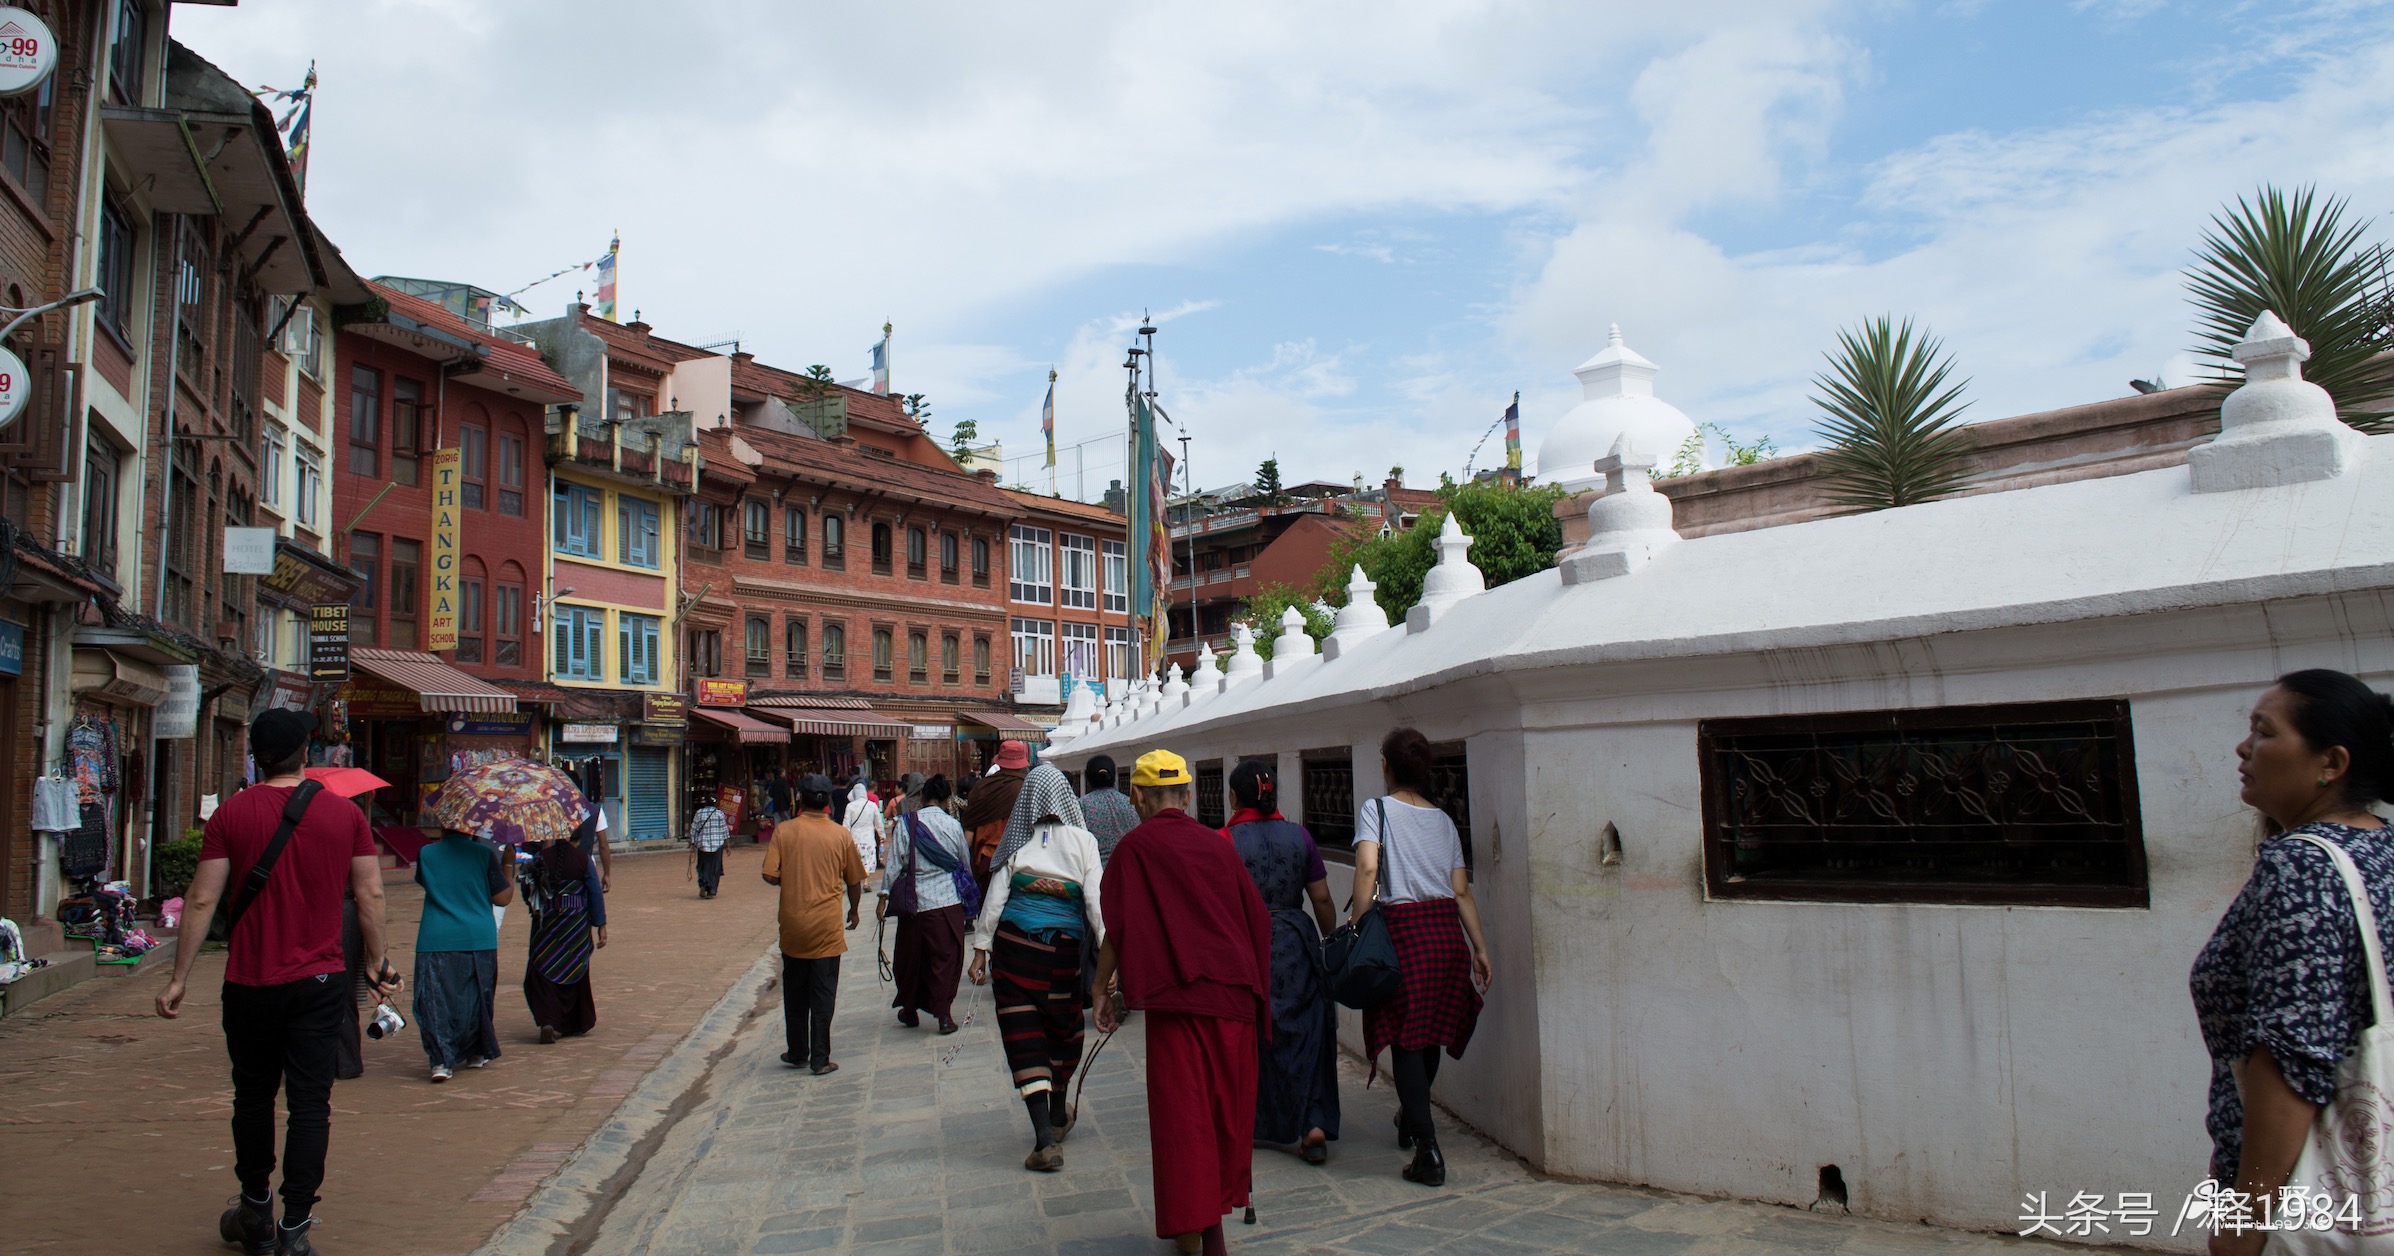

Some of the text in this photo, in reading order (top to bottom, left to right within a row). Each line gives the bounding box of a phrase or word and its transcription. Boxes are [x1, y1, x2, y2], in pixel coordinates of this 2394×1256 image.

[434, 453, 459, 465] ZORIG
[436, 469, 454, 613] THANGKA
[232, 544, 264, 554] HOTEL
[262, 553, 311, 592] TIBET
[294, 580, 327, 603] HOUSE
[311, 606, 349, 618] TIBET
[311, 620, 348, 632] HOUSE
[432, 617, 453, 628] ART
[431, 632, 457, 645] SCHOOL
[0, 635, 21, 661] Crafts
[352, 689, 378, 702] ZORIG
